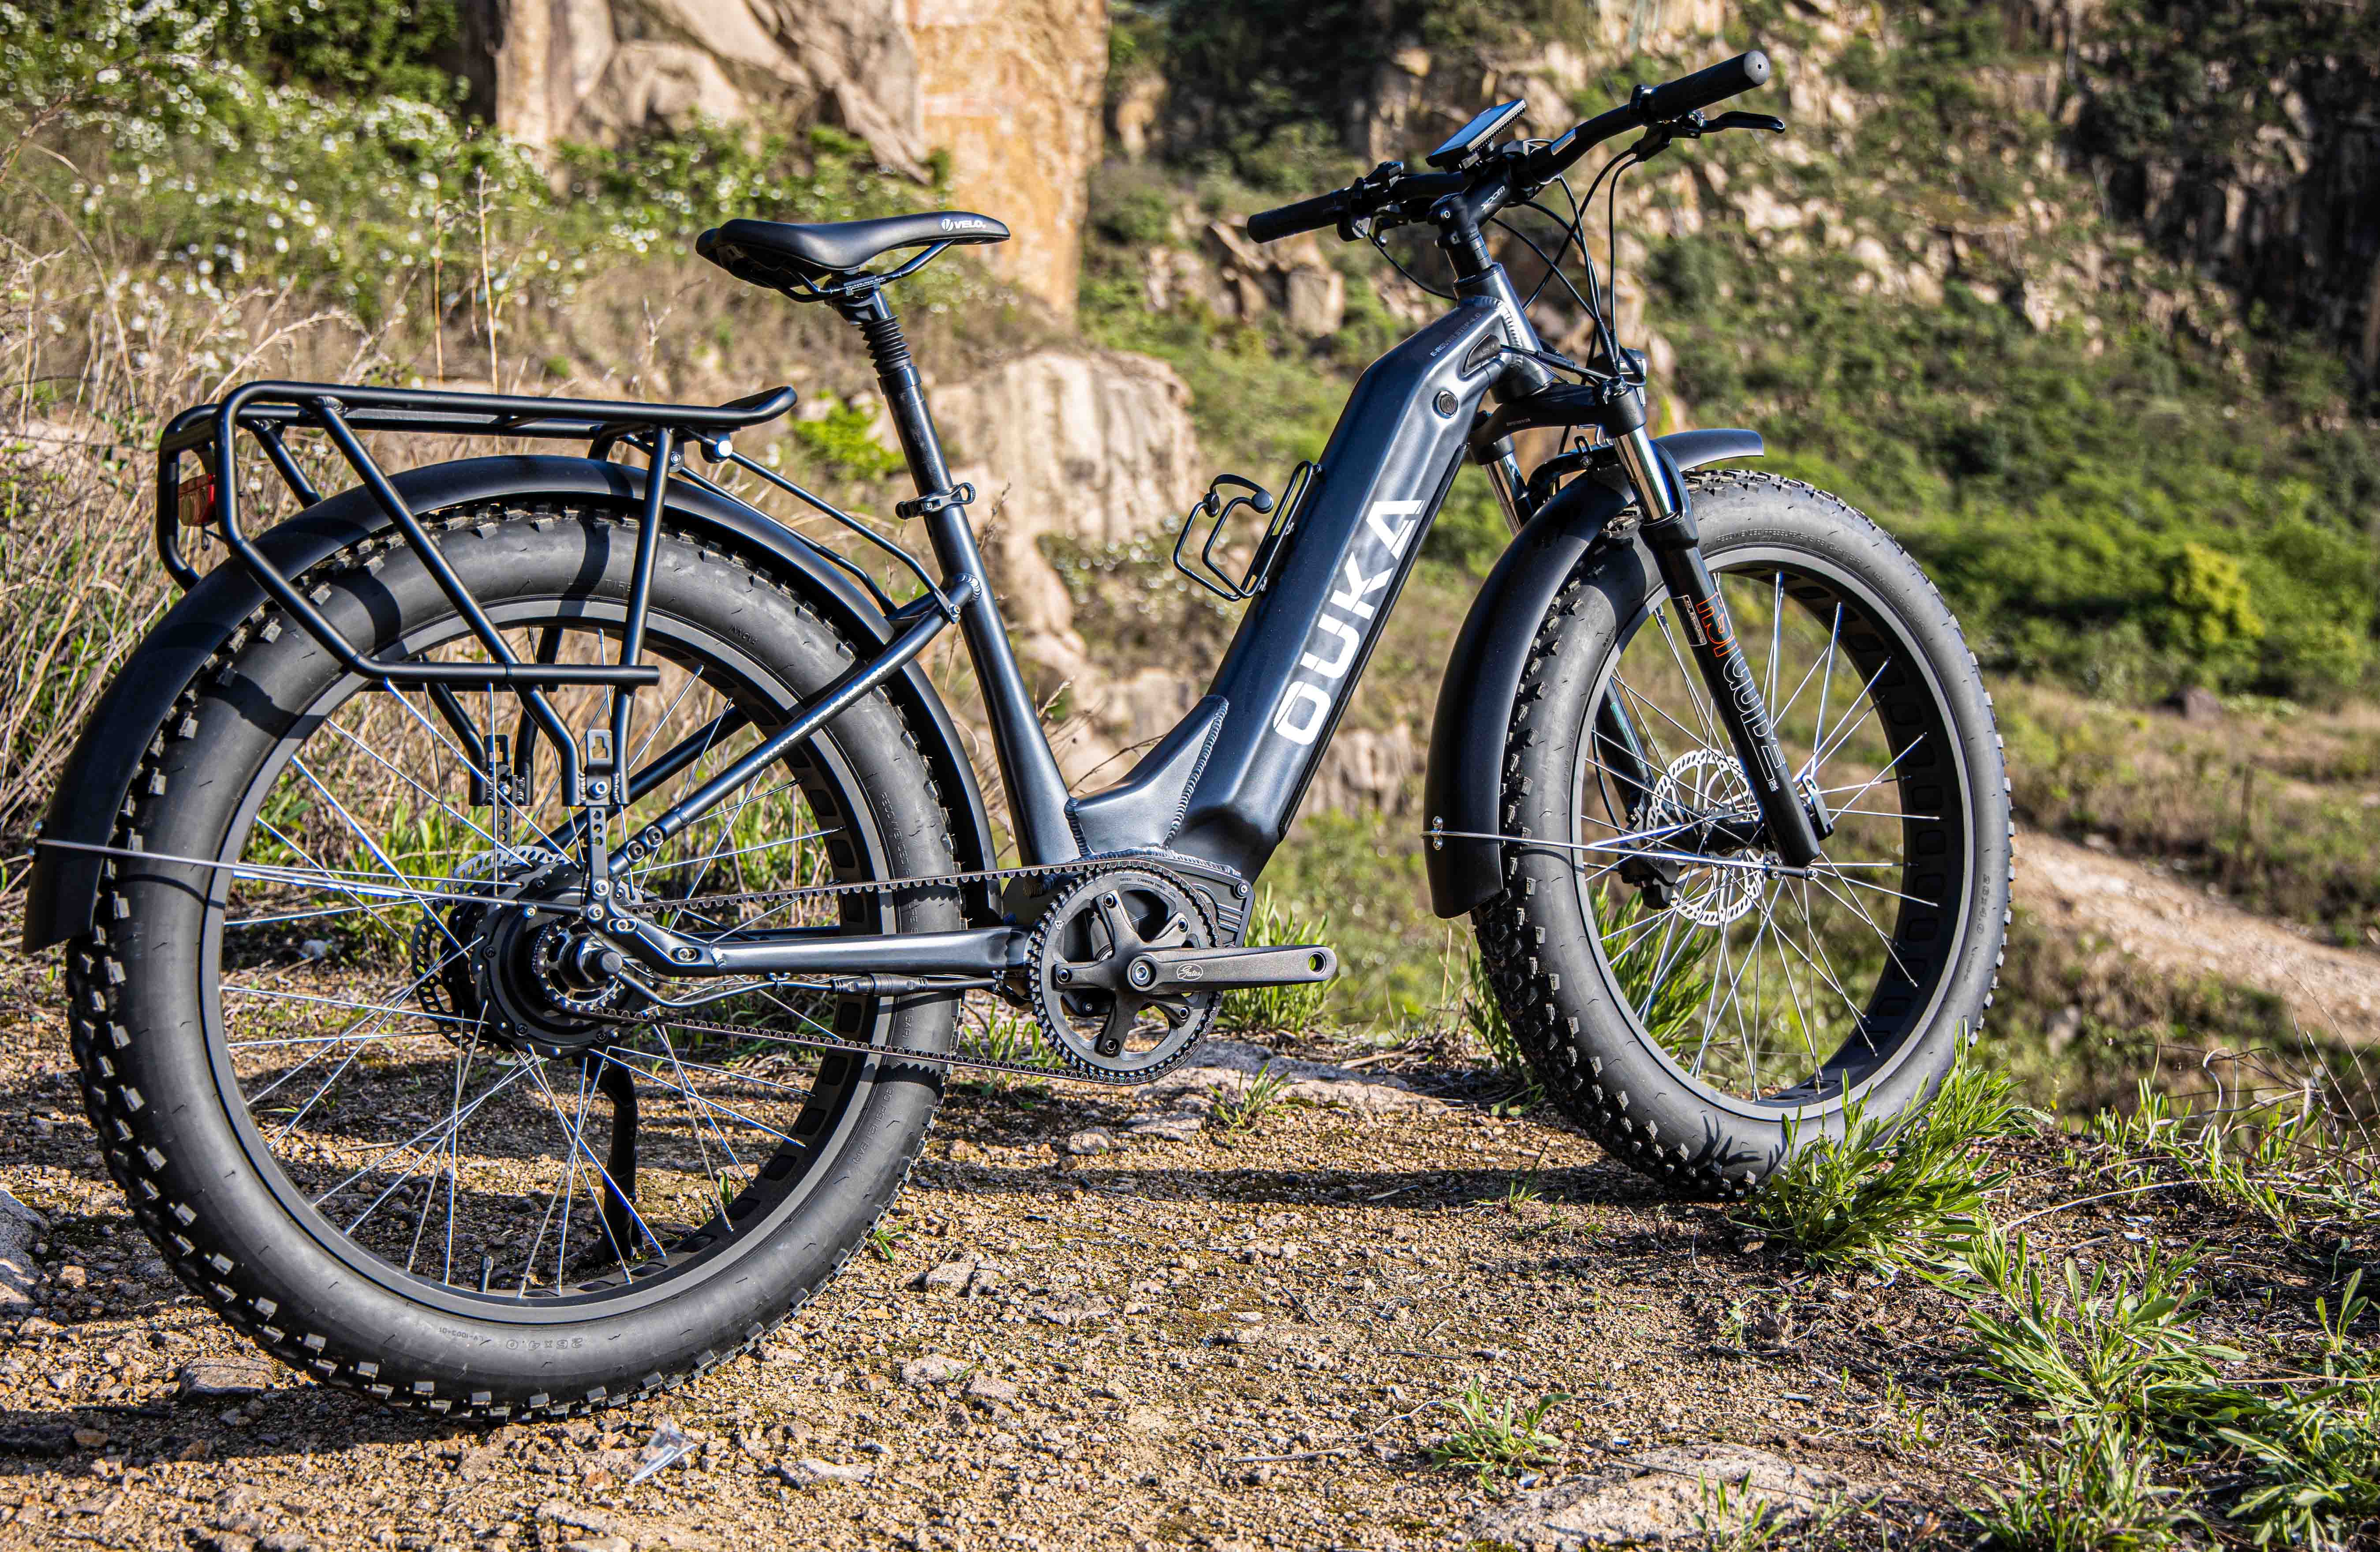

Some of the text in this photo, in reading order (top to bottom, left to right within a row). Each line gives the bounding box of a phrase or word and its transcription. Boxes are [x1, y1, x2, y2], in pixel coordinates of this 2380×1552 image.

[954, 221, 982, 230] VELO
[1273, 500, 1425, 745] OUKA
[1768, 779, 1779, 793] 26
[1180, 965, 1200, 979] Gates
[883, 1086, 893, 1102] 30
[874, 1104, 886, 1122] PSI
[852, 1142, 869, 1164] BAR)
